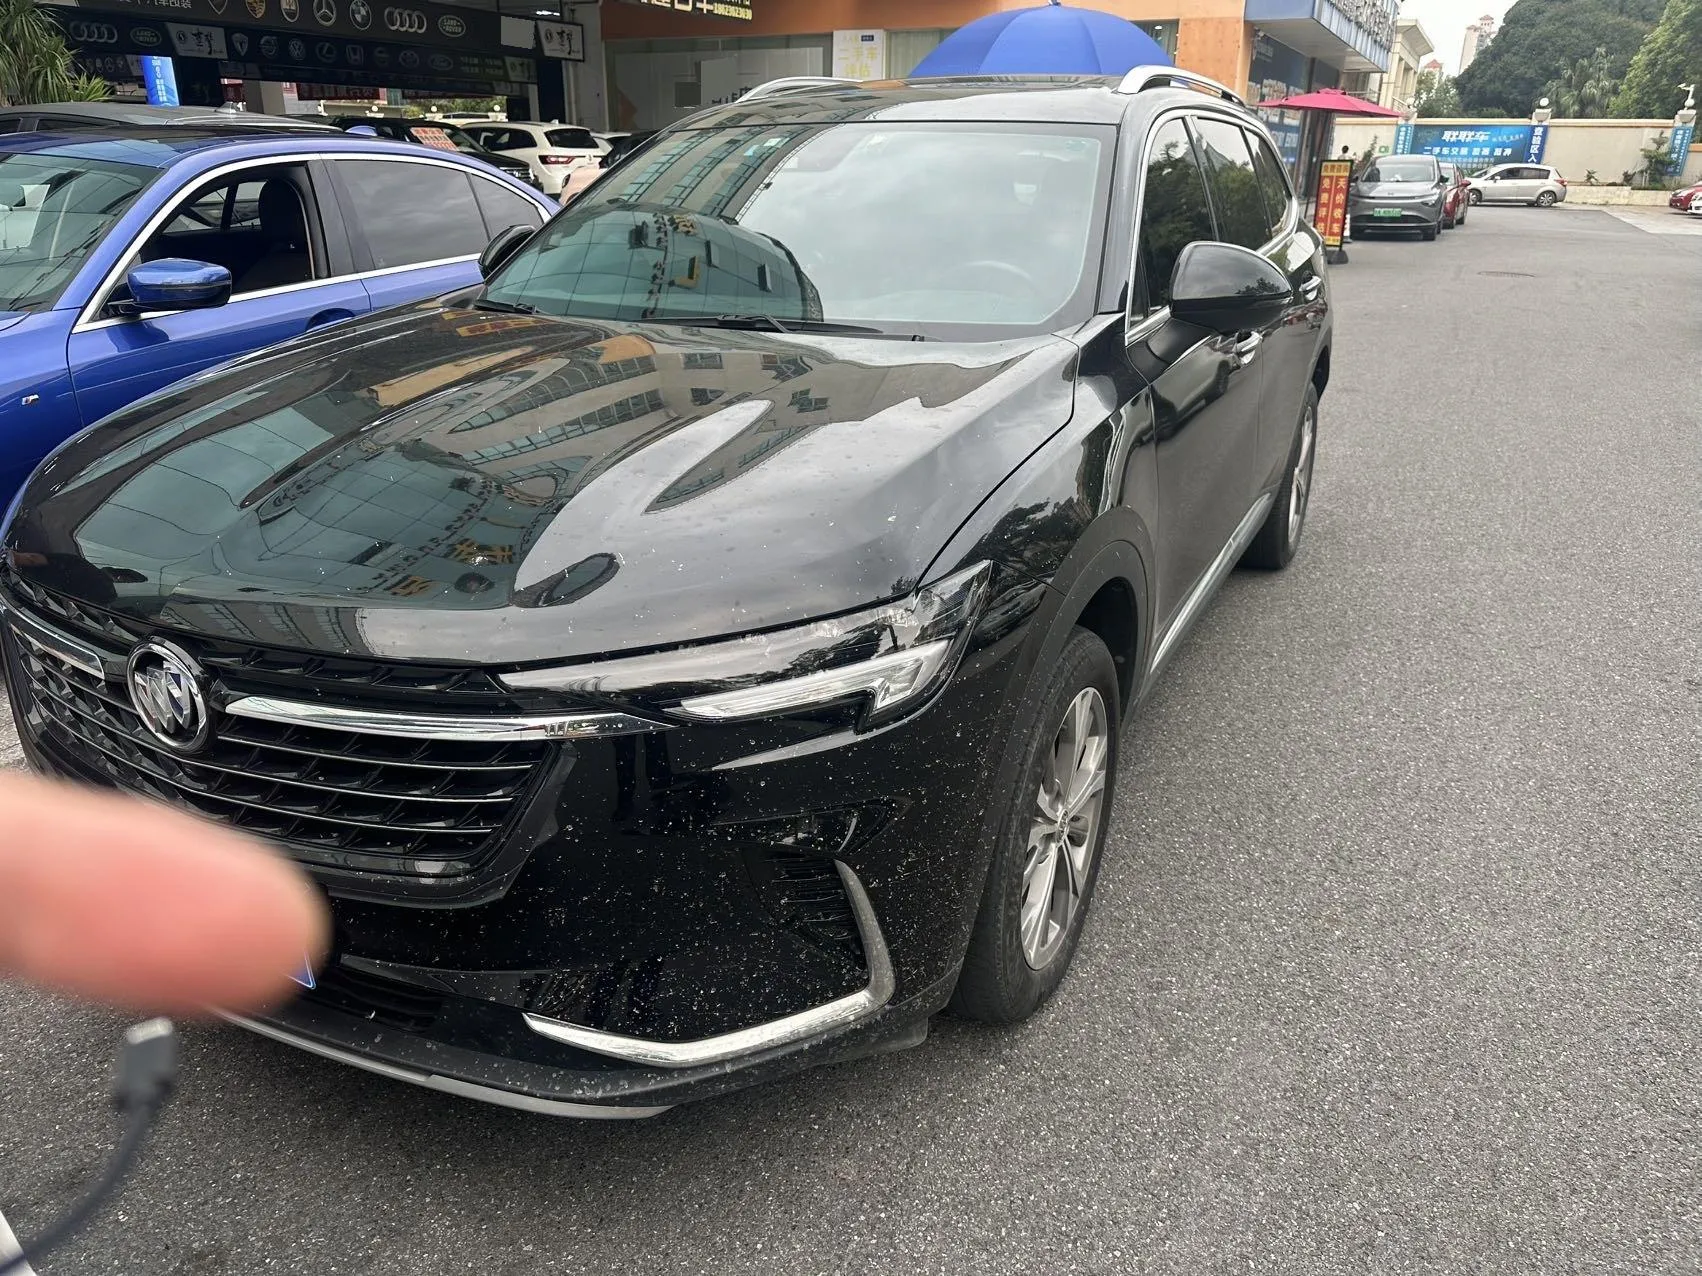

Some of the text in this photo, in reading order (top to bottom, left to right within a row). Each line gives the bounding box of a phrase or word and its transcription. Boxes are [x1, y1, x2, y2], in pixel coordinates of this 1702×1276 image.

[1442, 130, 1491, 142] 联联车
[1422, 146, 1469, 155] 二手车交易
